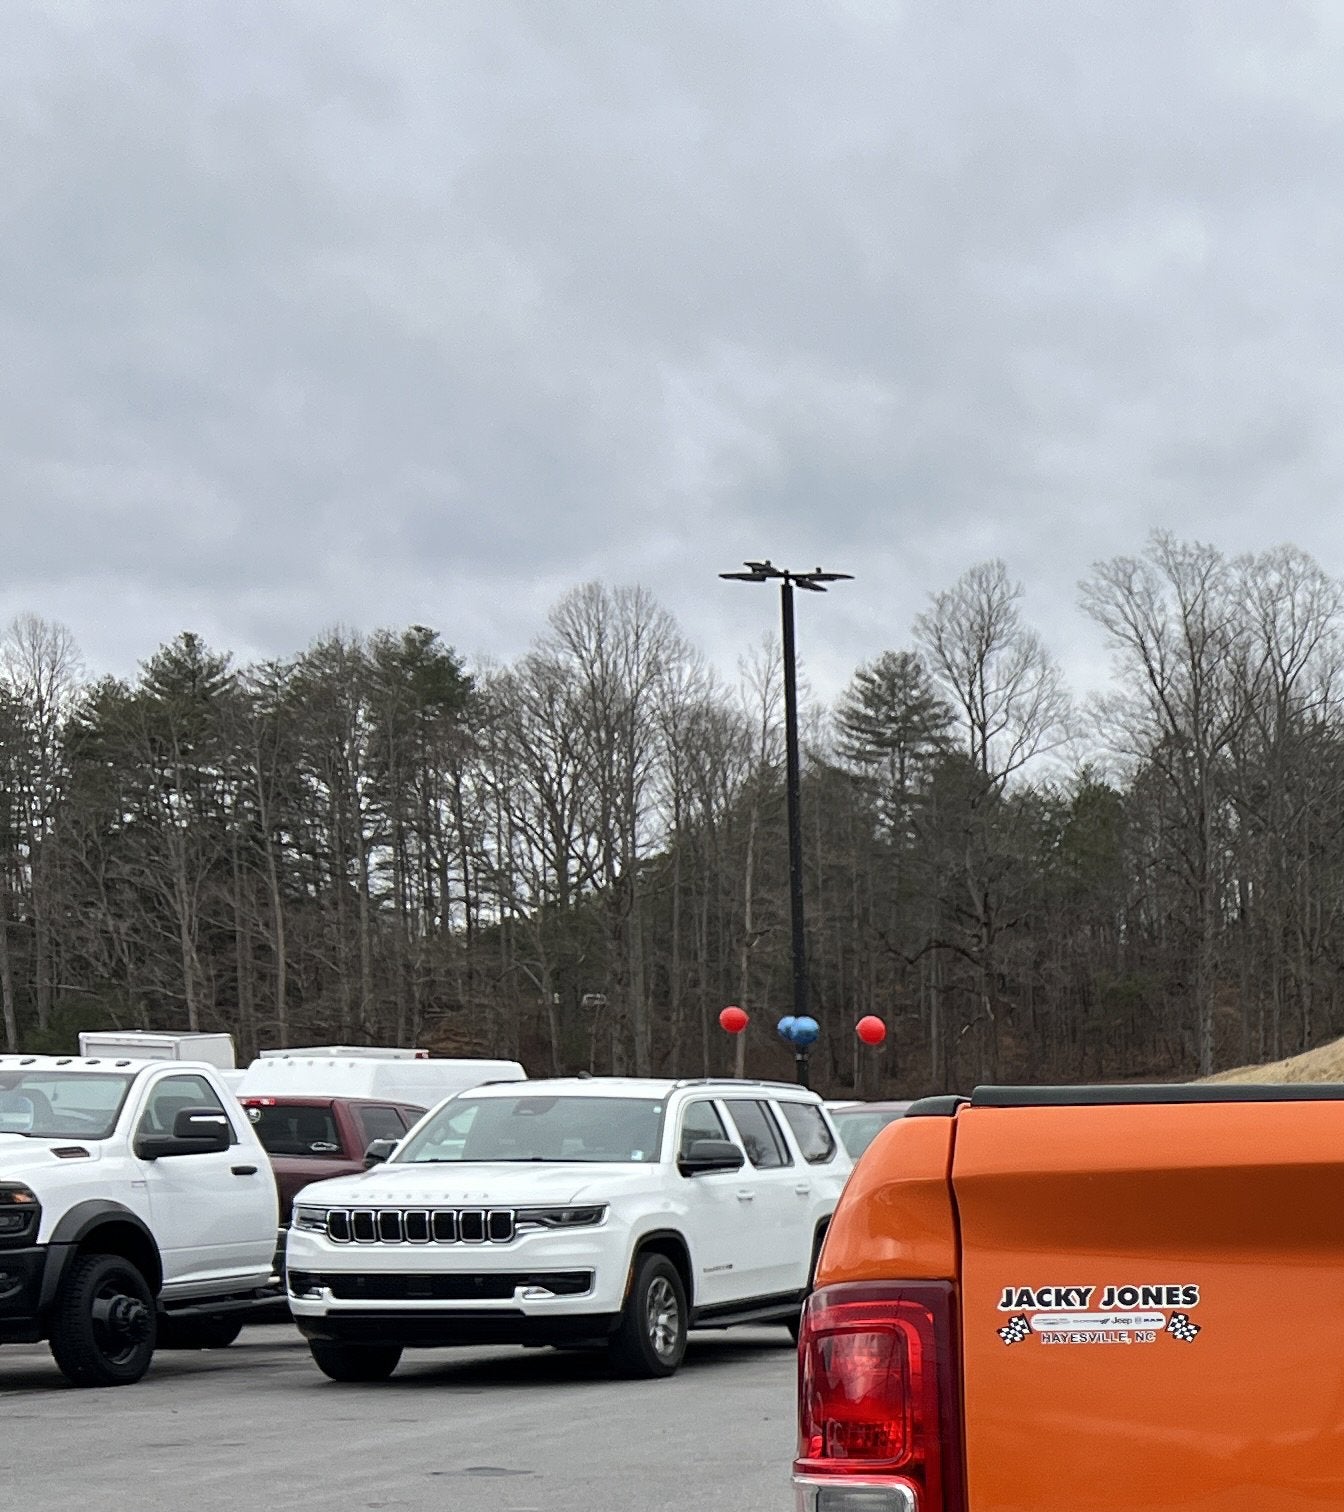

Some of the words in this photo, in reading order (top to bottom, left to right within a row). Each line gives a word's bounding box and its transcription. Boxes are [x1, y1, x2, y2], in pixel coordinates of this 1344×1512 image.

[1000, 1287, 1093, 1308] JACKY
[1101, 1285, 1198, 1306] JONES
[1041, 1331, 1131, 1344] HAYESVILLE,
[1135, 1331, 1156, 1342] NC
